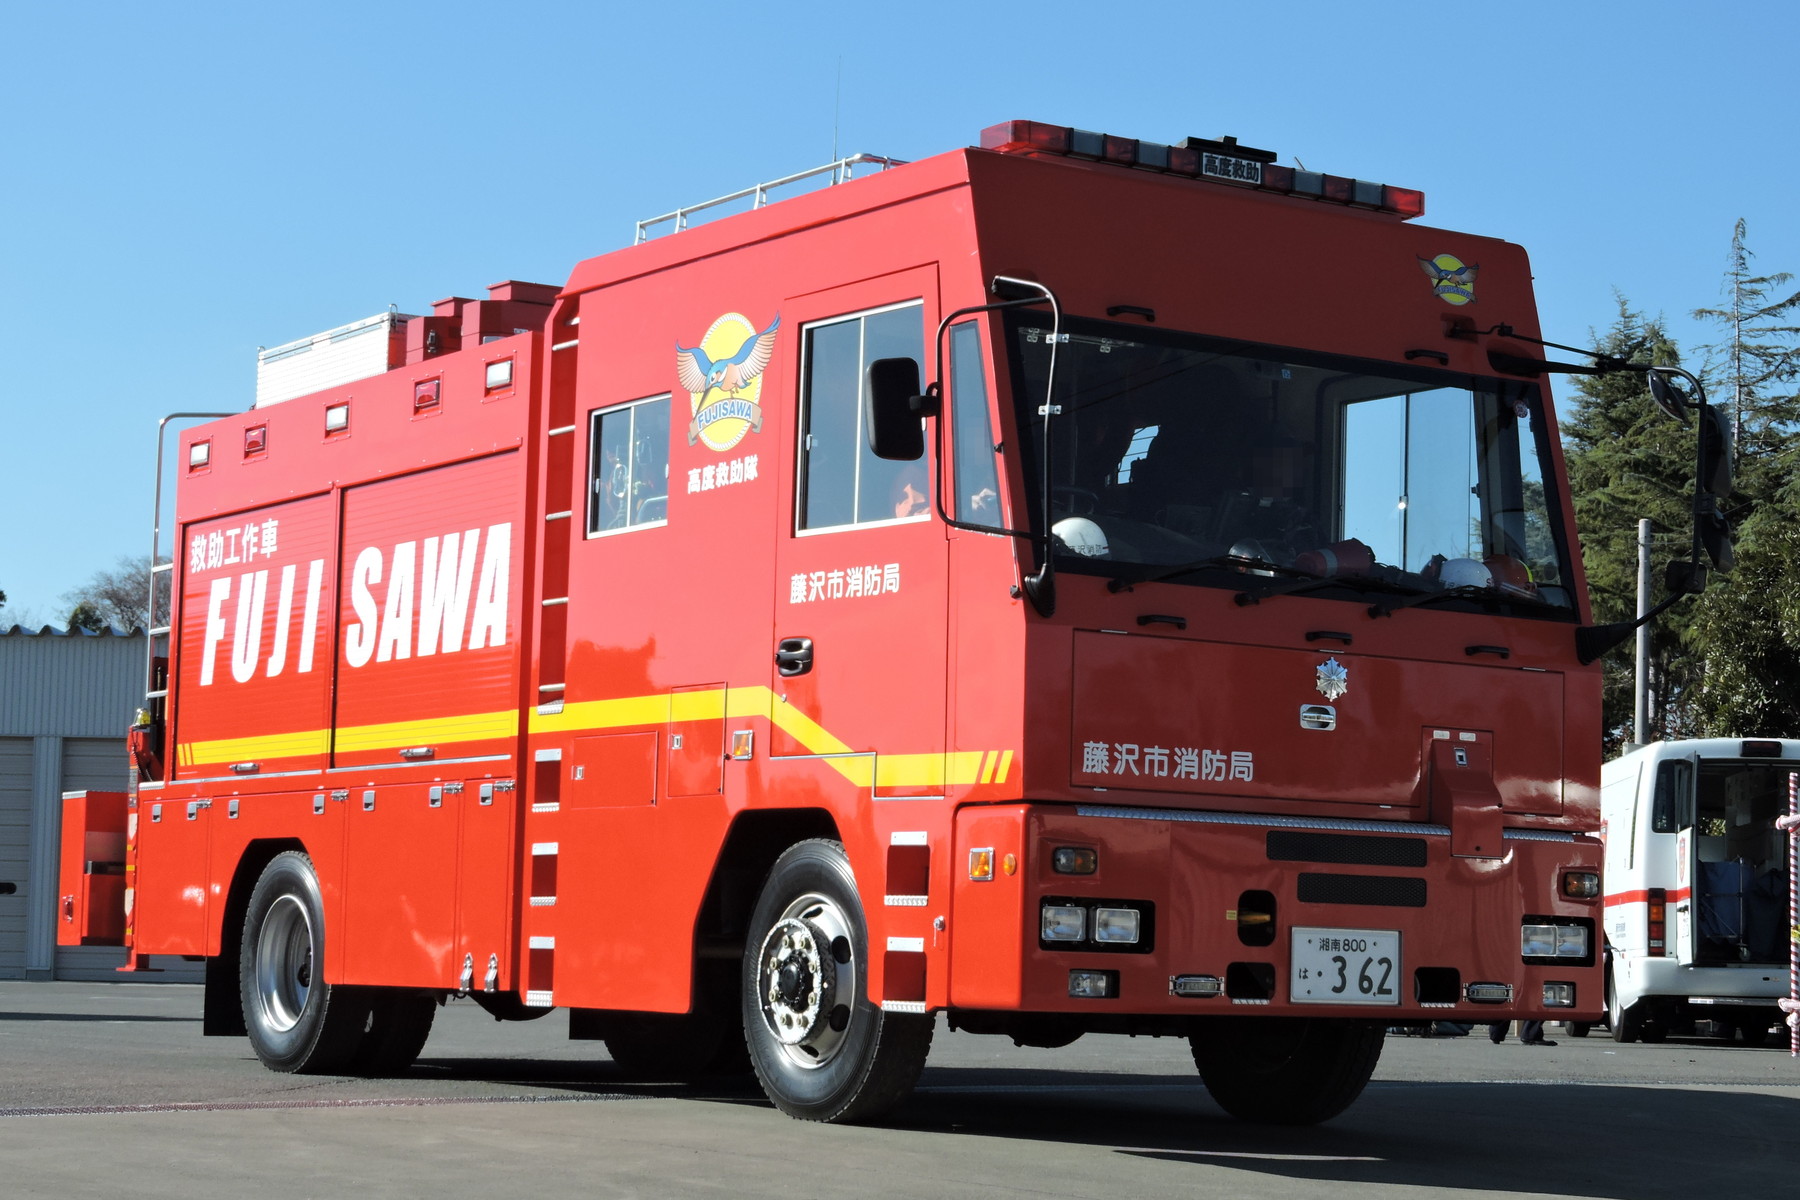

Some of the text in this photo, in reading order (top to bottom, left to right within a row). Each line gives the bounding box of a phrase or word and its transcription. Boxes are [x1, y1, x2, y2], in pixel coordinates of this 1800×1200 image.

[1204, 154, 1259, 182] 高度救助
[697, 401, 752, 429] FUJISAWA
[688, 454, 758, 494] 高度救助隊
[191, 518, 278, 573] 救助工作車
[200, 522, 511, 686] FUJI SAWA
[790, 563, 899, 604] 藤沢市消防局
[1083, 740, 1254, 782] 藤沢市消防局
